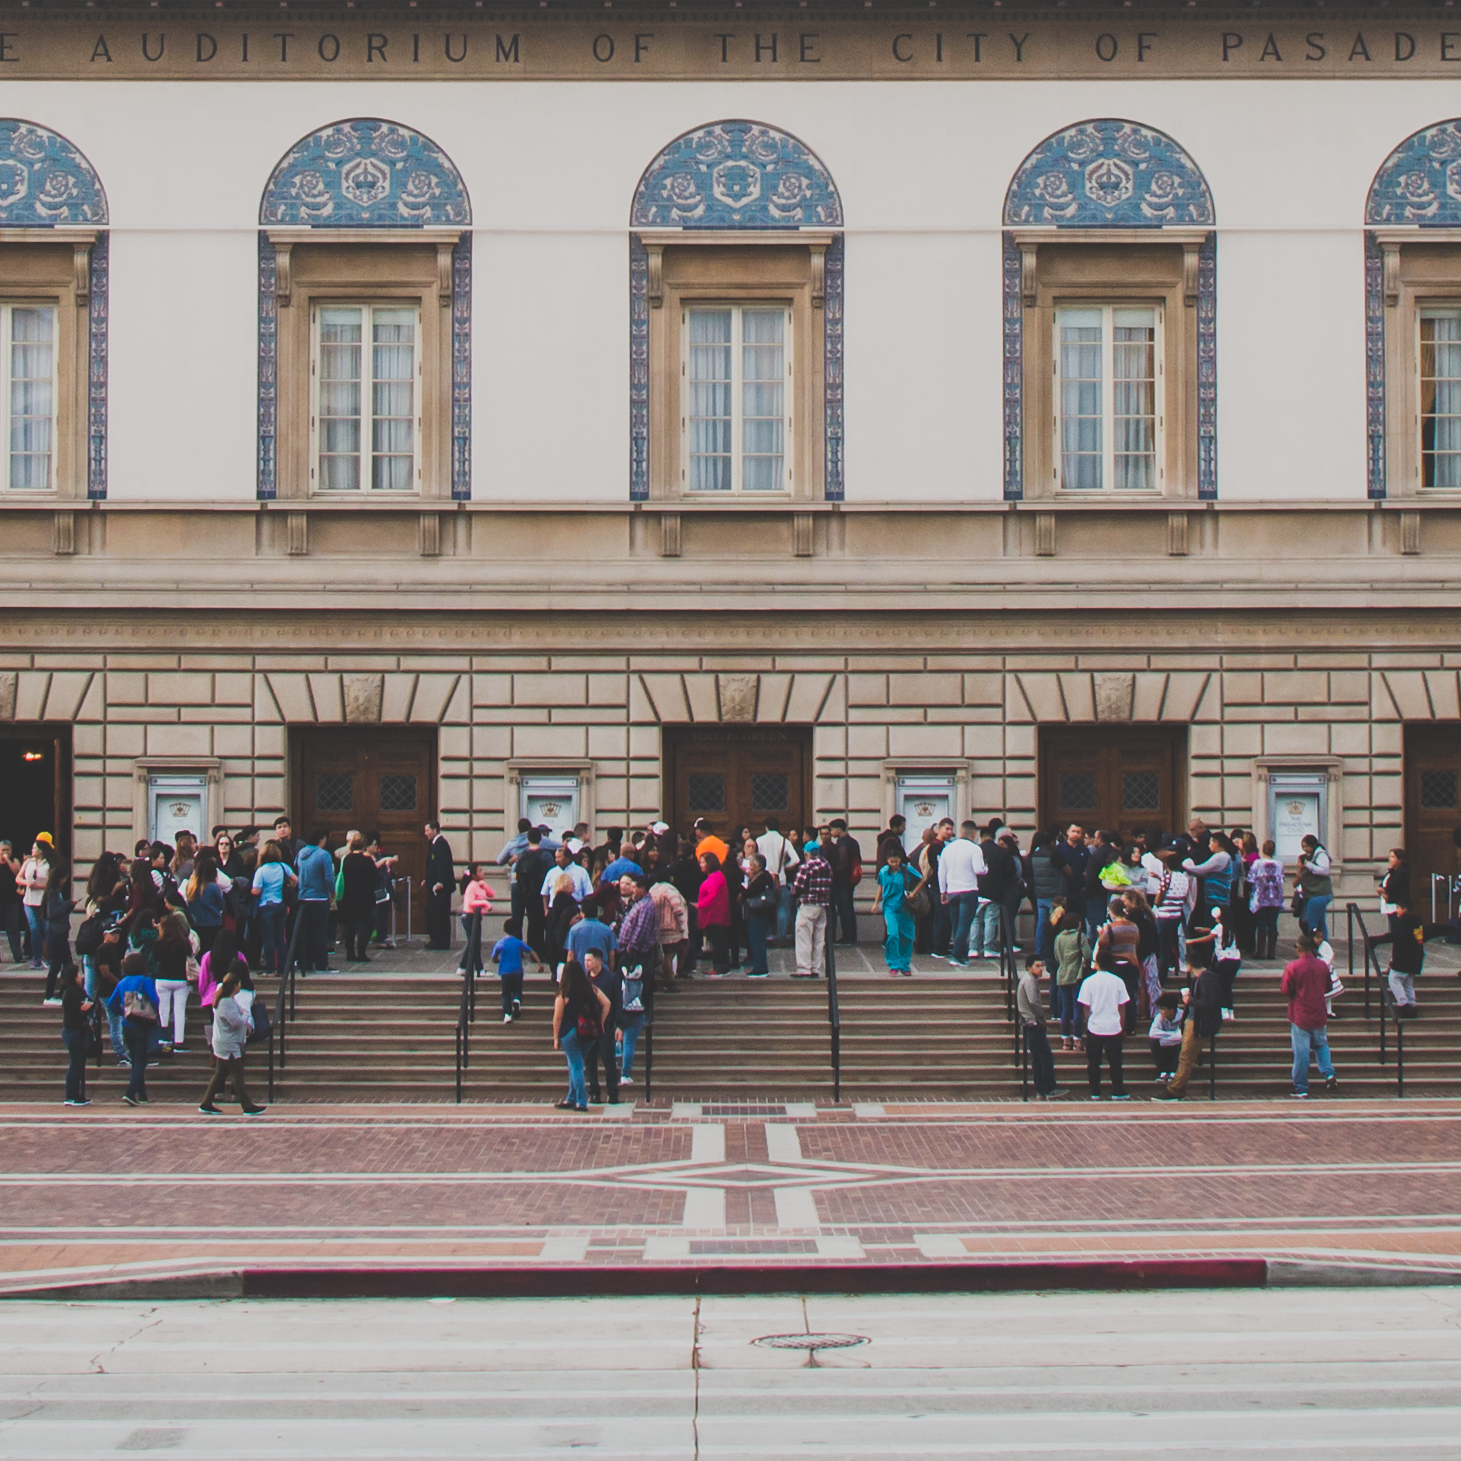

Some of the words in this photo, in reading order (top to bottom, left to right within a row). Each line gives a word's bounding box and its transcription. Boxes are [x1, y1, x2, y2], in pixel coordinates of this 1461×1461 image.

[87, 33, 520, 63] AUDITORIUM
[593, 33, 654, 63] OF
[714, 33, 822, 63] THE
[892, 33, 1029, 63] CITY
[1095, 33, 1158, 63] OF
